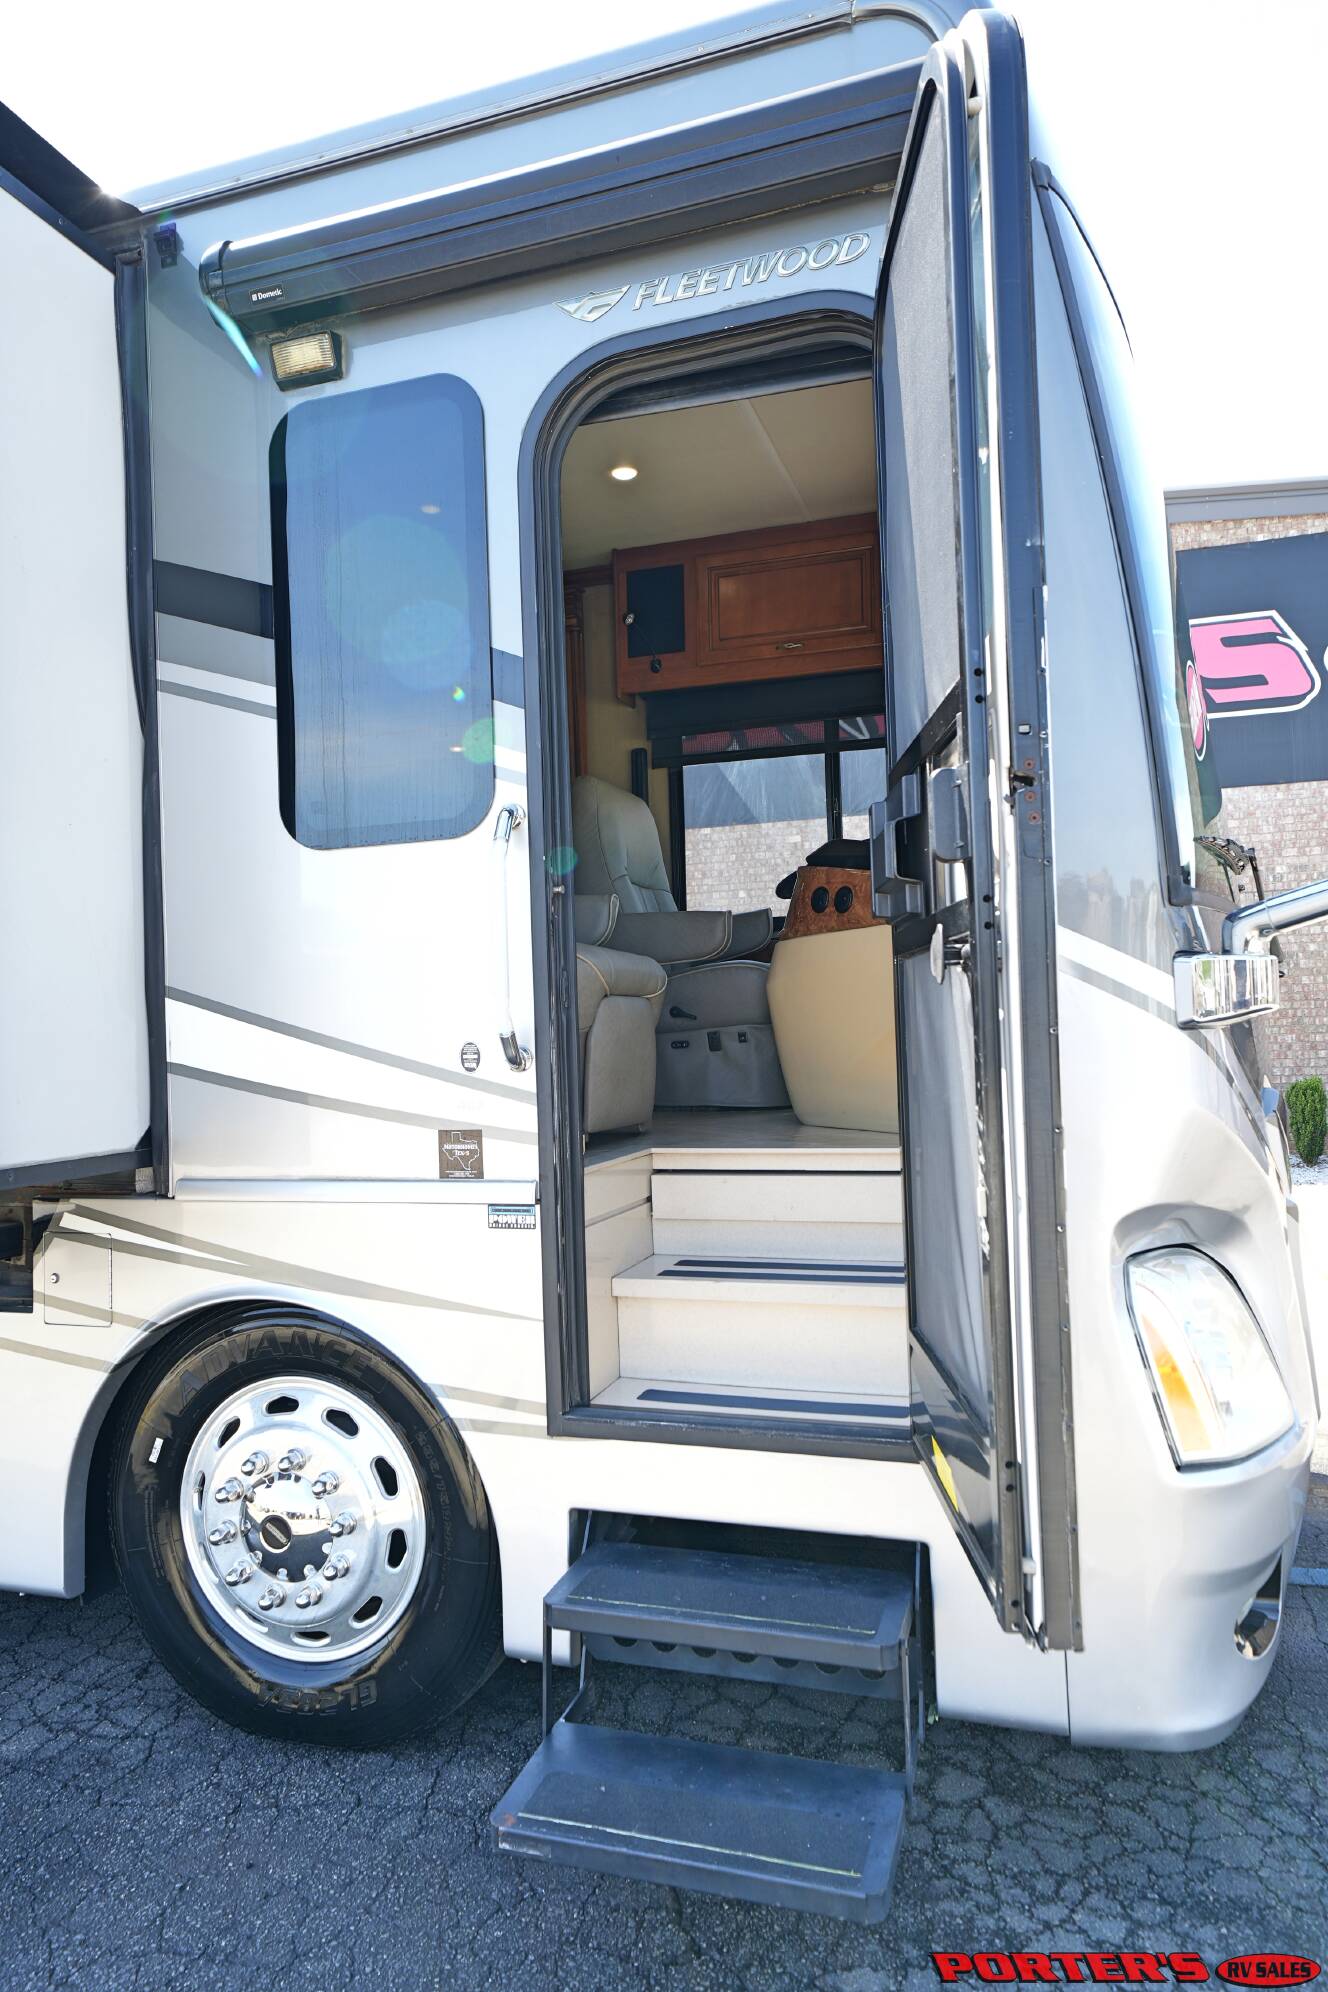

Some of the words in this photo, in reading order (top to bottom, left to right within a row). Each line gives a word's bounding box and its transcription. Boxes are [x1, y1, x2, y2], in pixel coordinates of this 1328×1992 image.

[258, 288, 282, 301] Dometic
[632, 232, 871, 311] FLEETWOOD
[178, 1329, 375, 1408] ADVANCE
